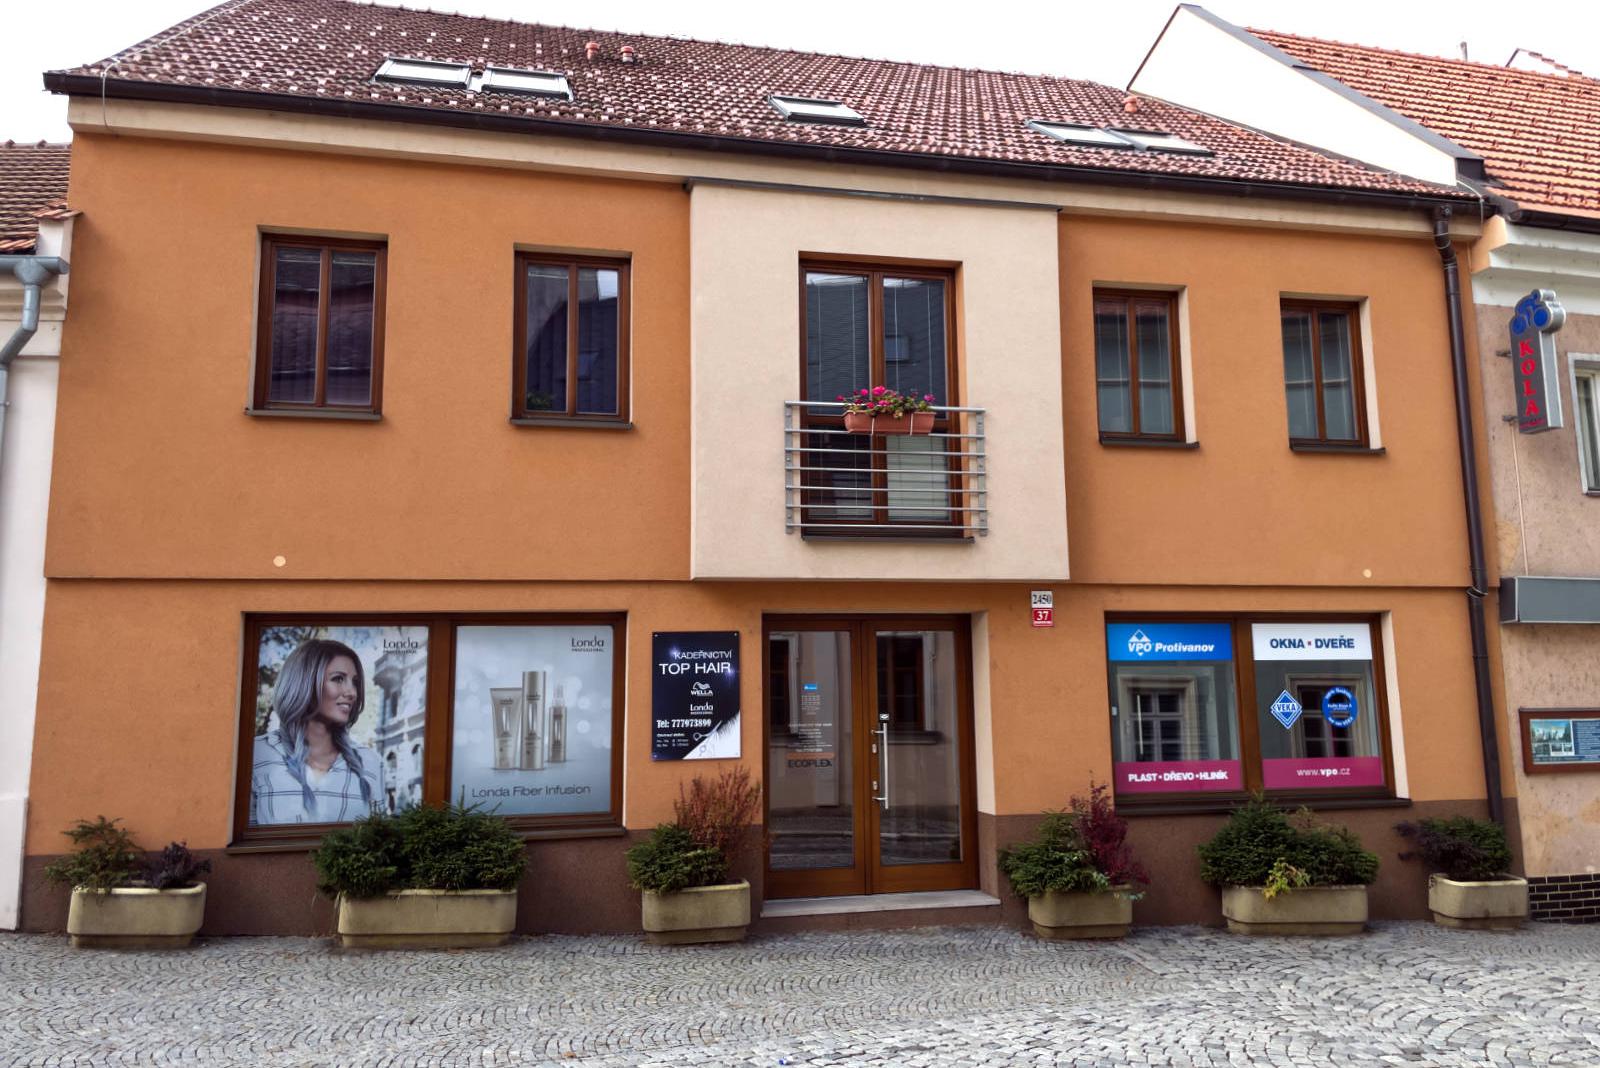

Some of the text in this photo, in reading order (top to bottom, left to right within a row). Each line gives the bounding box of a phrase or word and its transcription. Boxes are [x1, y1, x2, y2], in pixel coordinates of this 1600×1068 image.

[1519, 337, 1539, 417] KOLA
[1032, 594, 1052, 604] 2450
[1036, 610, 1049, 621] 37
[383, 637, 418, 648] Londa
[571, 635, 605, 647] Londa
[1270, 635, 1355, 649] OKNA DVEŘE
[1128, 642, 1215, 653] VPO Protivanov
[674, 649, 732, 660] KADEŘNICTVÍ
[659, 661, 732, 675] TOP HAIR
[690, 701, 714, 711] Londa
[1276, 703, 1296, 712] VEKA
[1128, 769, 1229, 782] PLAST DŘEVO HLINÍK
[1296, 768, 1351, 777] www.vpo.cz
[472, 784, 591, 798] Londa Fiber Infusion
